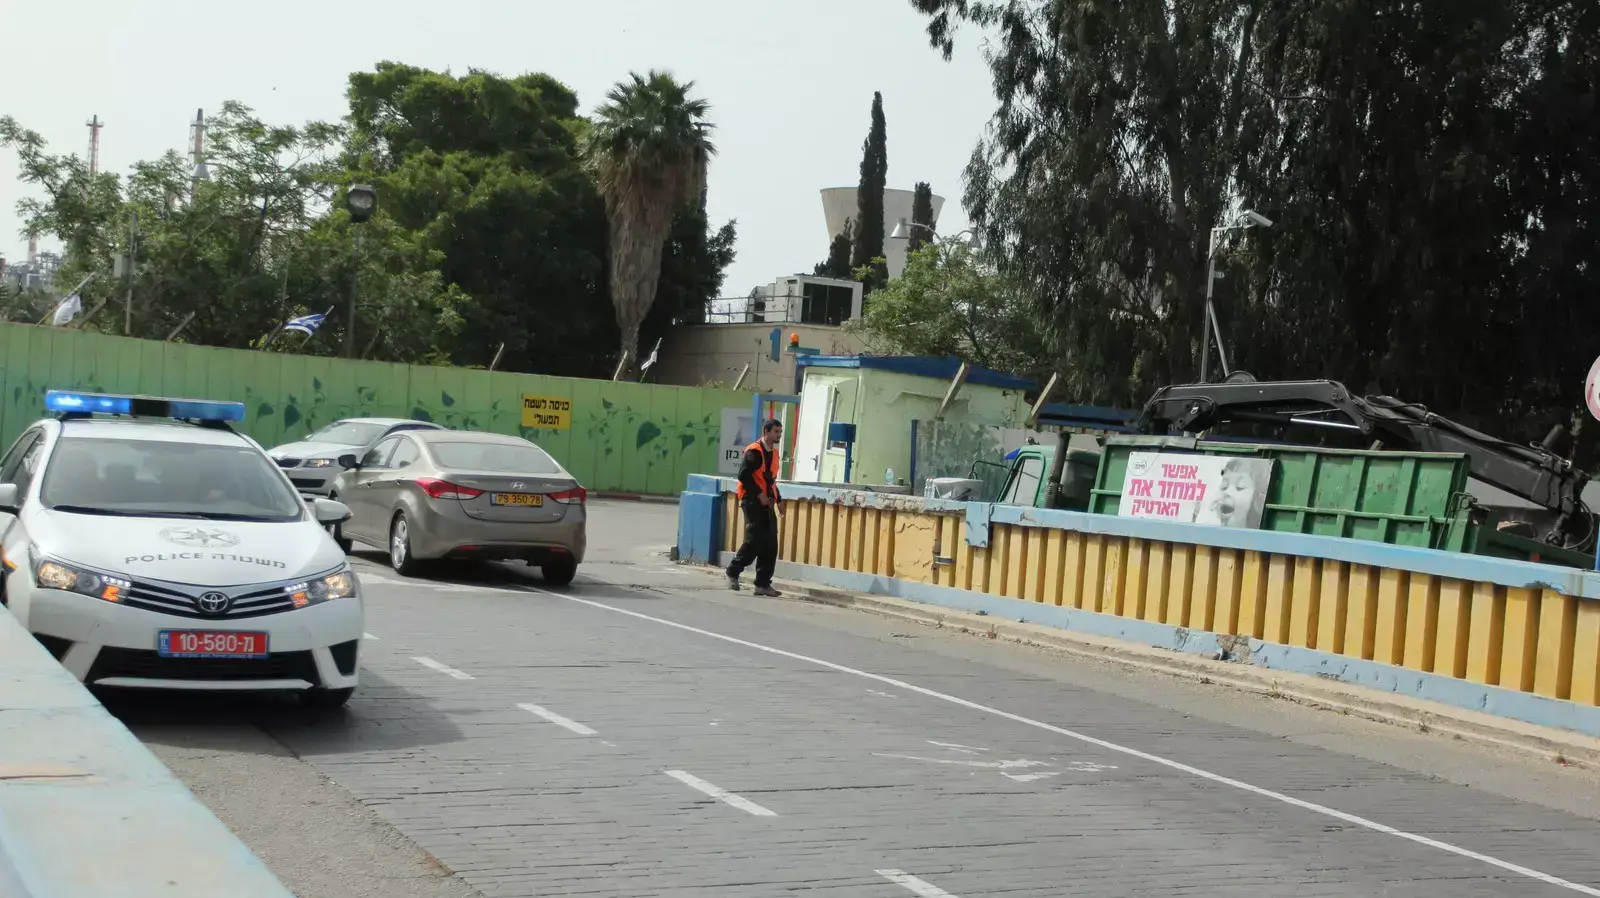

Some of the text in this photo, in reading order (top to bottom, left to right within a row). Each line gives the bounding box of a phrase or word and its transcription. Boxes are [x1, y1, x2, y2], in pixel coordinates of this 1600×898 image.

[769, 328, 781, 363] 1
[524, 398, 570, 411] כניסה לשטח
[534, 413, 560, 425] תפעולי
[1161, 463, 1199, 479] אפשר
[1128, 478, 1207, 501] למחזר את
[1130, 499, 1180, 517] הארטיק
[125, 552, 203, 564] POLICE
[211, 553, 286, 569] משטרה
